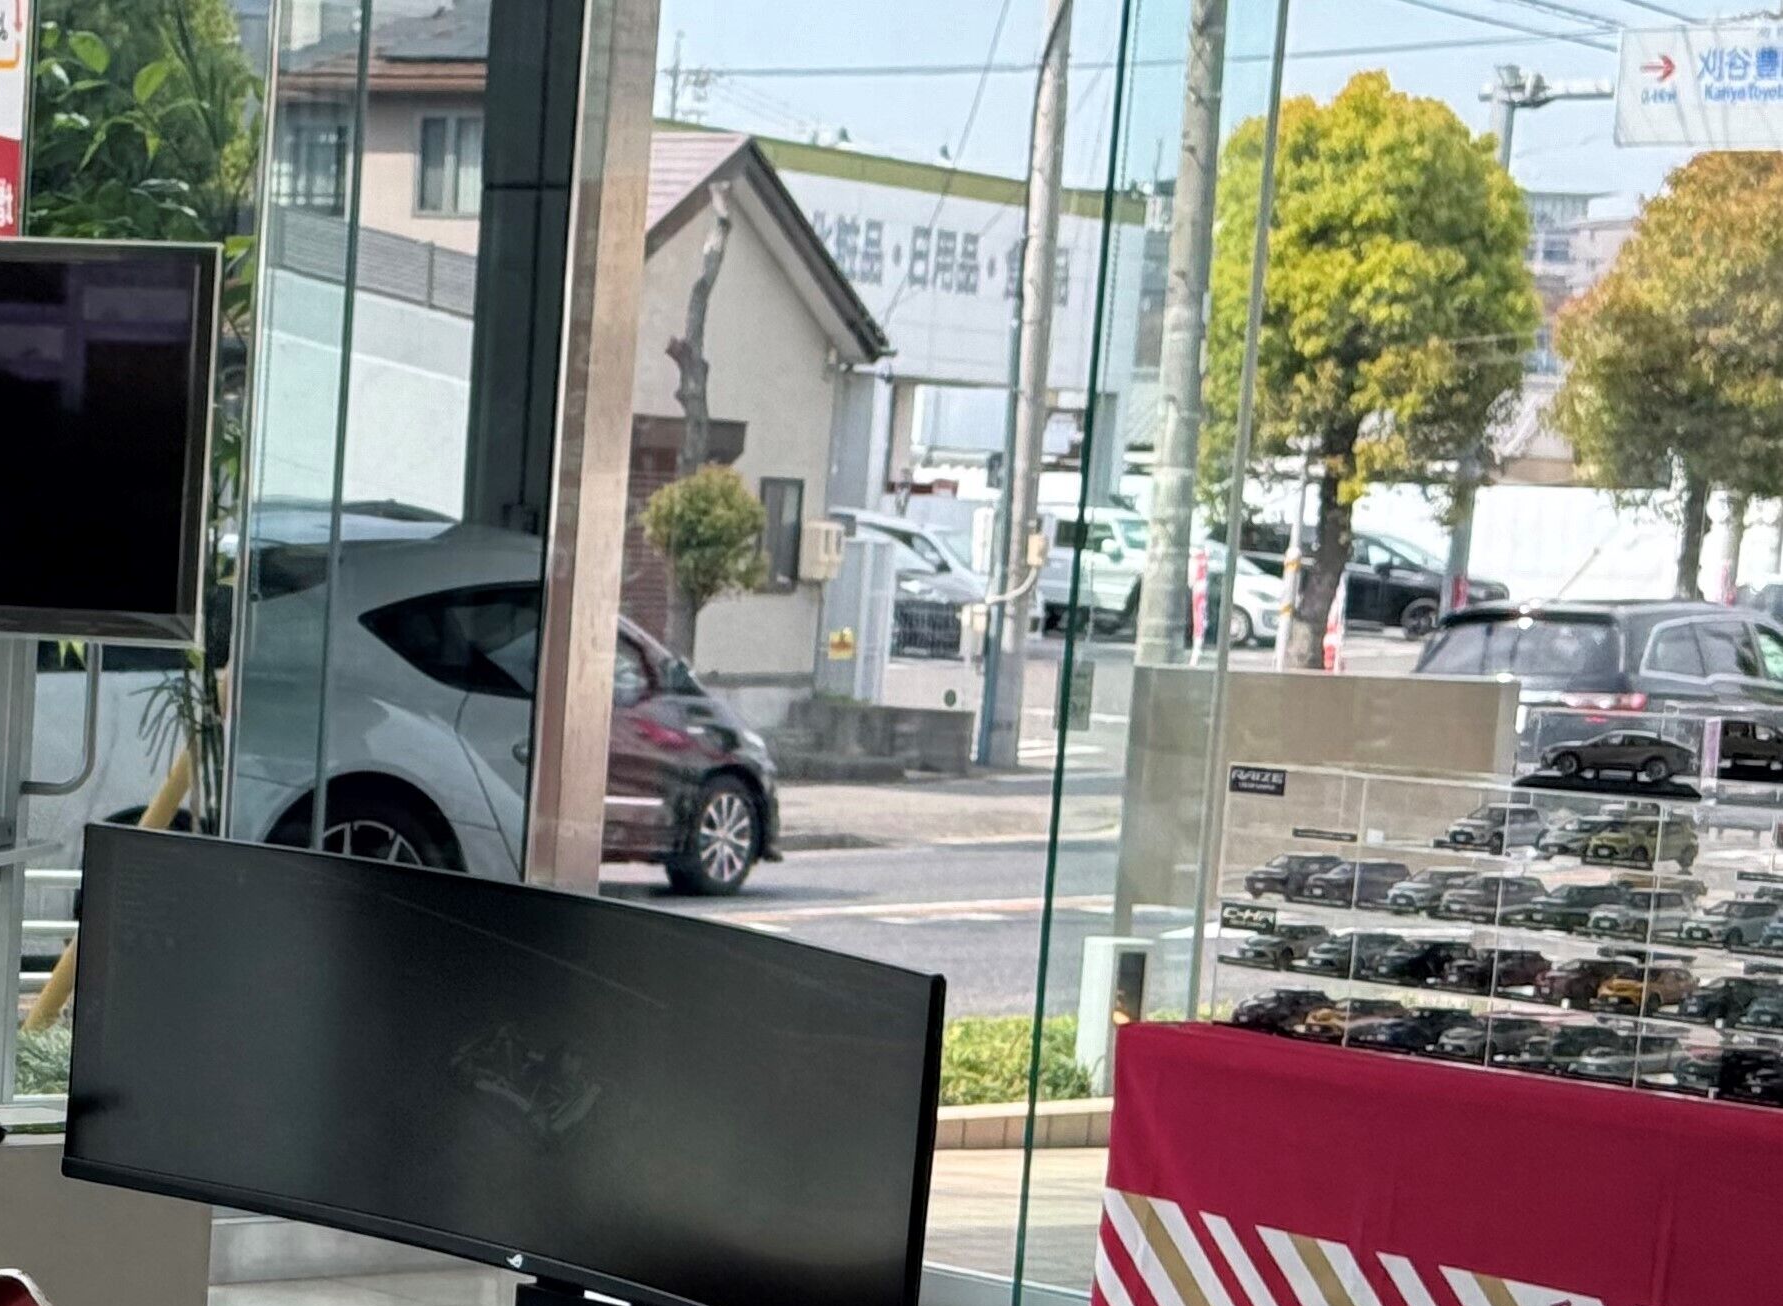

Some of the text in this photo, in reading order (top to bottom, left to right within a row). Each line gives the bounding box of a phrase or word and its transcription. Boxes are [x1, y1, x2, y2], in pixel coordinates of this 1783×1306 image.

[1697, 47, 1783, 80] 刈谷豊
[1231, 767, 1284, 784] RAIZE
